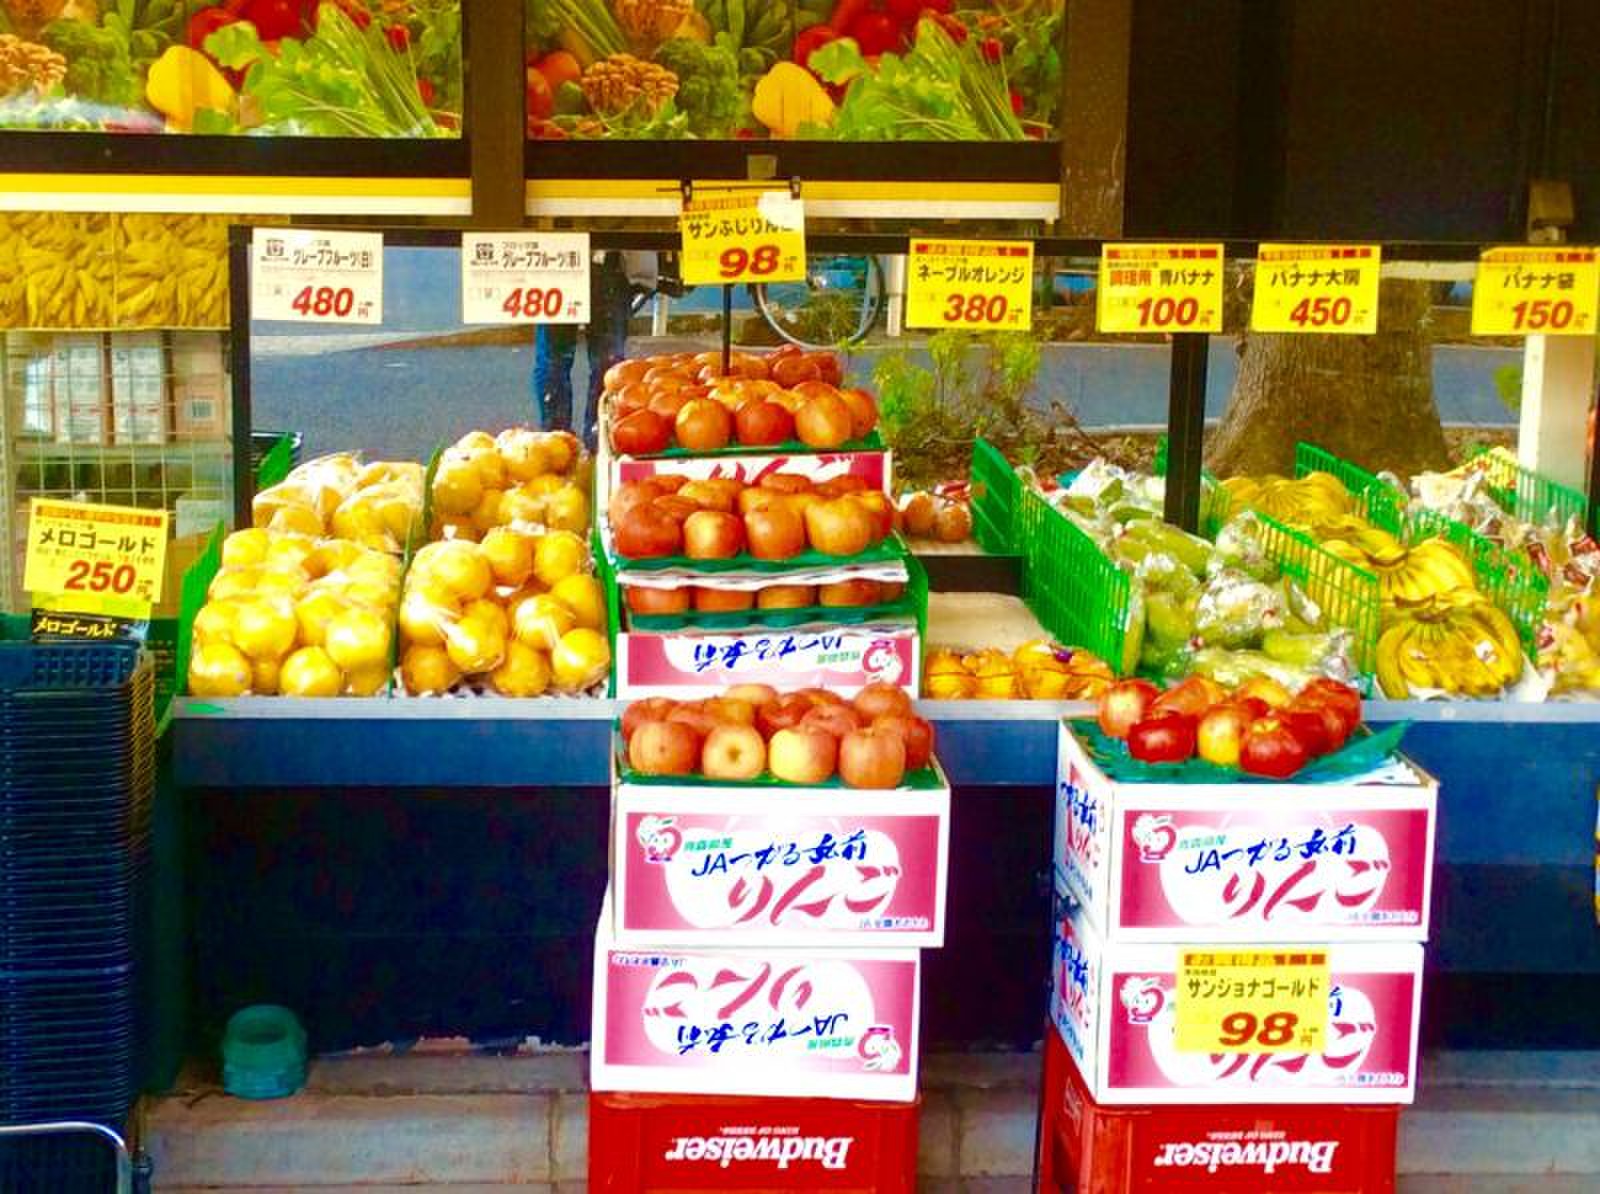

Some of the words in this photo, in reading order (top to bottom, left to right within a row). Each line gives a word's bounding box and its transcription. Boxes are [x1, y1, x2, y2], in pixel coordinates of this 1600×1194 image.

[687, 218, 795, 239] サンふじりん
[719, 244, 781, 279] 98
[917, 264, 1025, 285] ネーブルオレンジ
[291, 285, 355, 318] 480
[502, 287, 564, 319] 480
[943, 293, 1009, 324] 380
[1137, 296, 1200, 327] 100
[1289, 296, 1353, 327] 450
[1512, 300, 1574, 330] 150
[39, 527, 156, 553] メロゴールド
[63, 559, 137, 594] 250
[33, 617, 118, 637] メロゴールド
[727, 864, 900, 923] りんご
[1221, 858, 1390, 922] りんご
[642, 961, 813, 1021] りんご
[1187, 976, 1320, 999] サンジョナゴールド
[1218, 1011, 1299, 1047] 98
[664, 1135, 855, 1169] Budweiser
[1153, 1141, 1340, 1174] Budweiser
